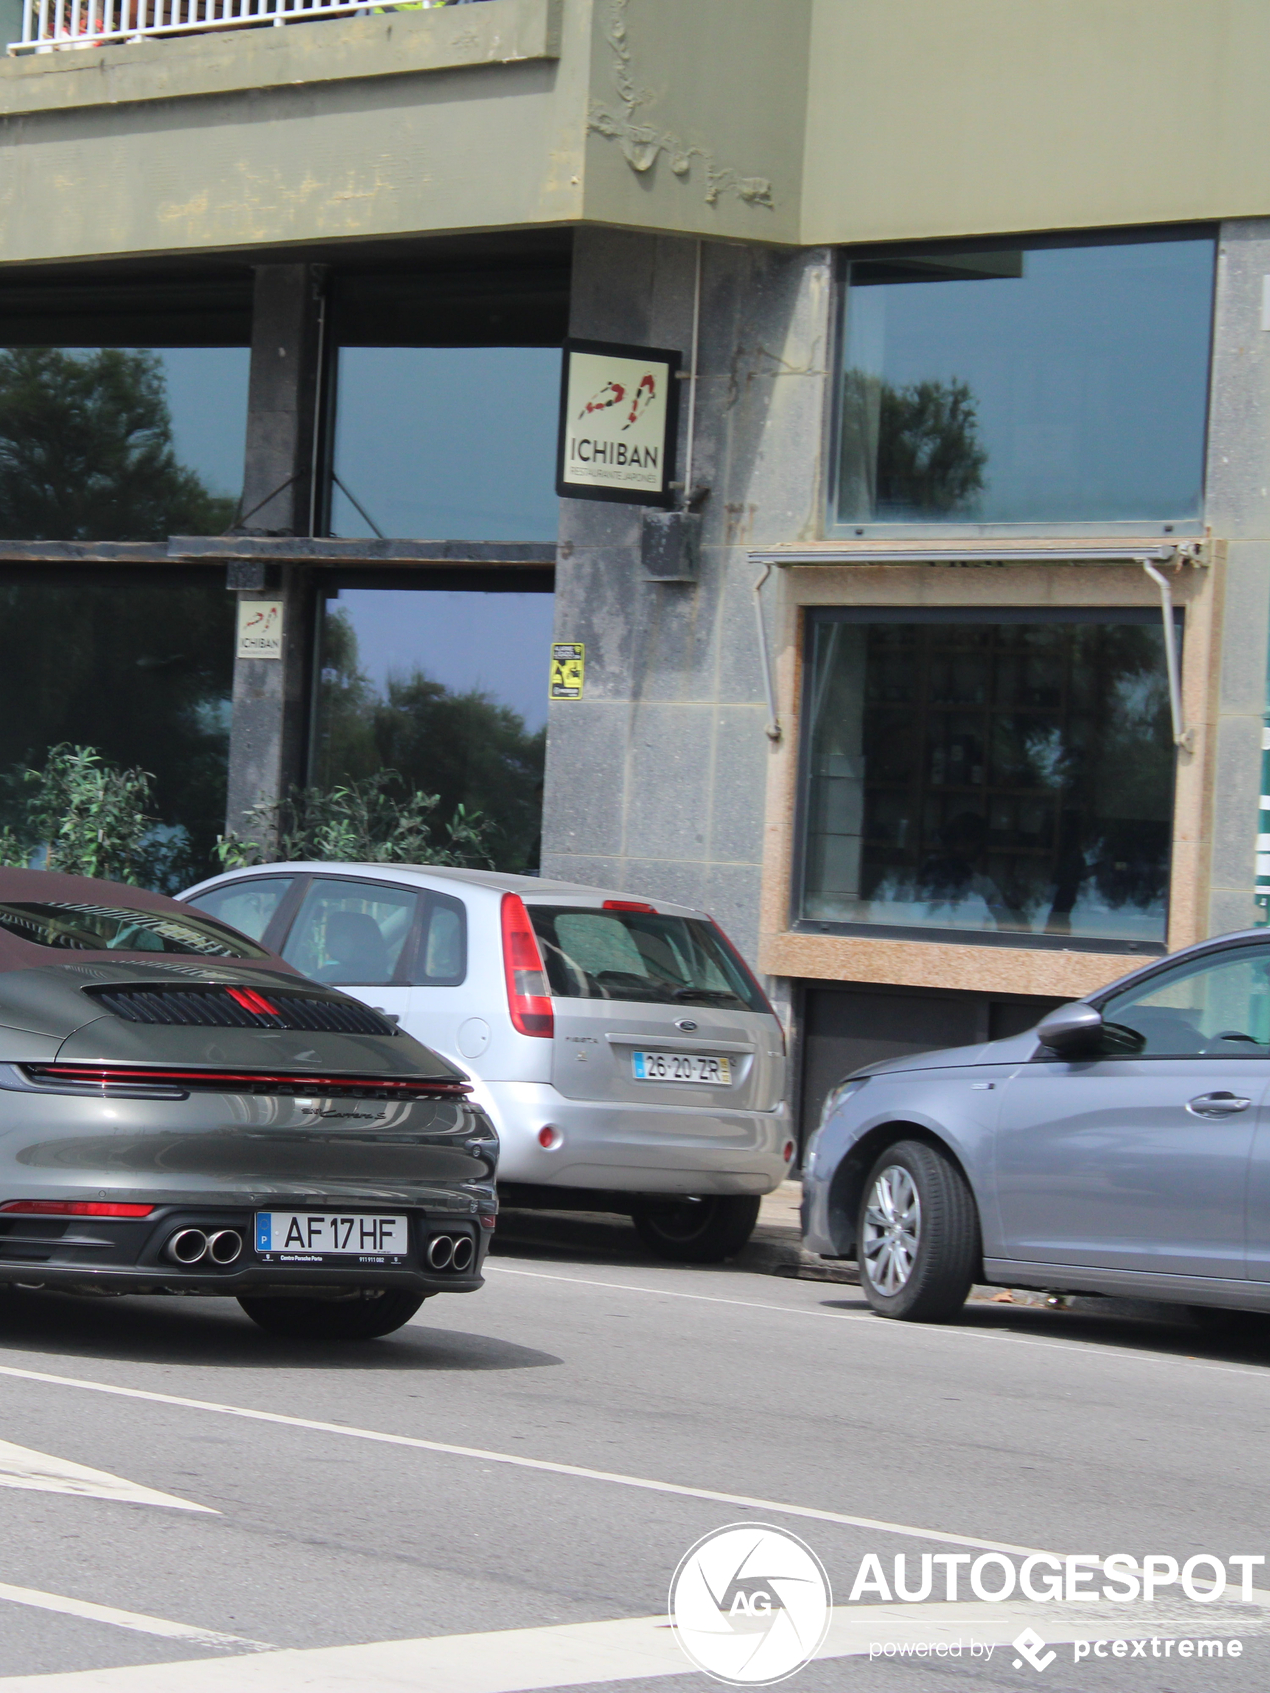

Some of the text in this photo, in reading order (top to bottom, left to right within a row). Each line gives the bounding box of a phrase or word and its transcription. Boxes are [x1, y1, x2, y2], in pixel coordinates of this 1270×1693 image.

[571, 437, 658, 469] ICHIBAN
[570, 466, 622, 480] RESTAURANTE
[240, 637, 279, 649] ICHIBAN
[320, 1109, 373, 1119] Carrera
[374, 1112, 387, 1120] S
[261, 1236, 268, 1245] P
